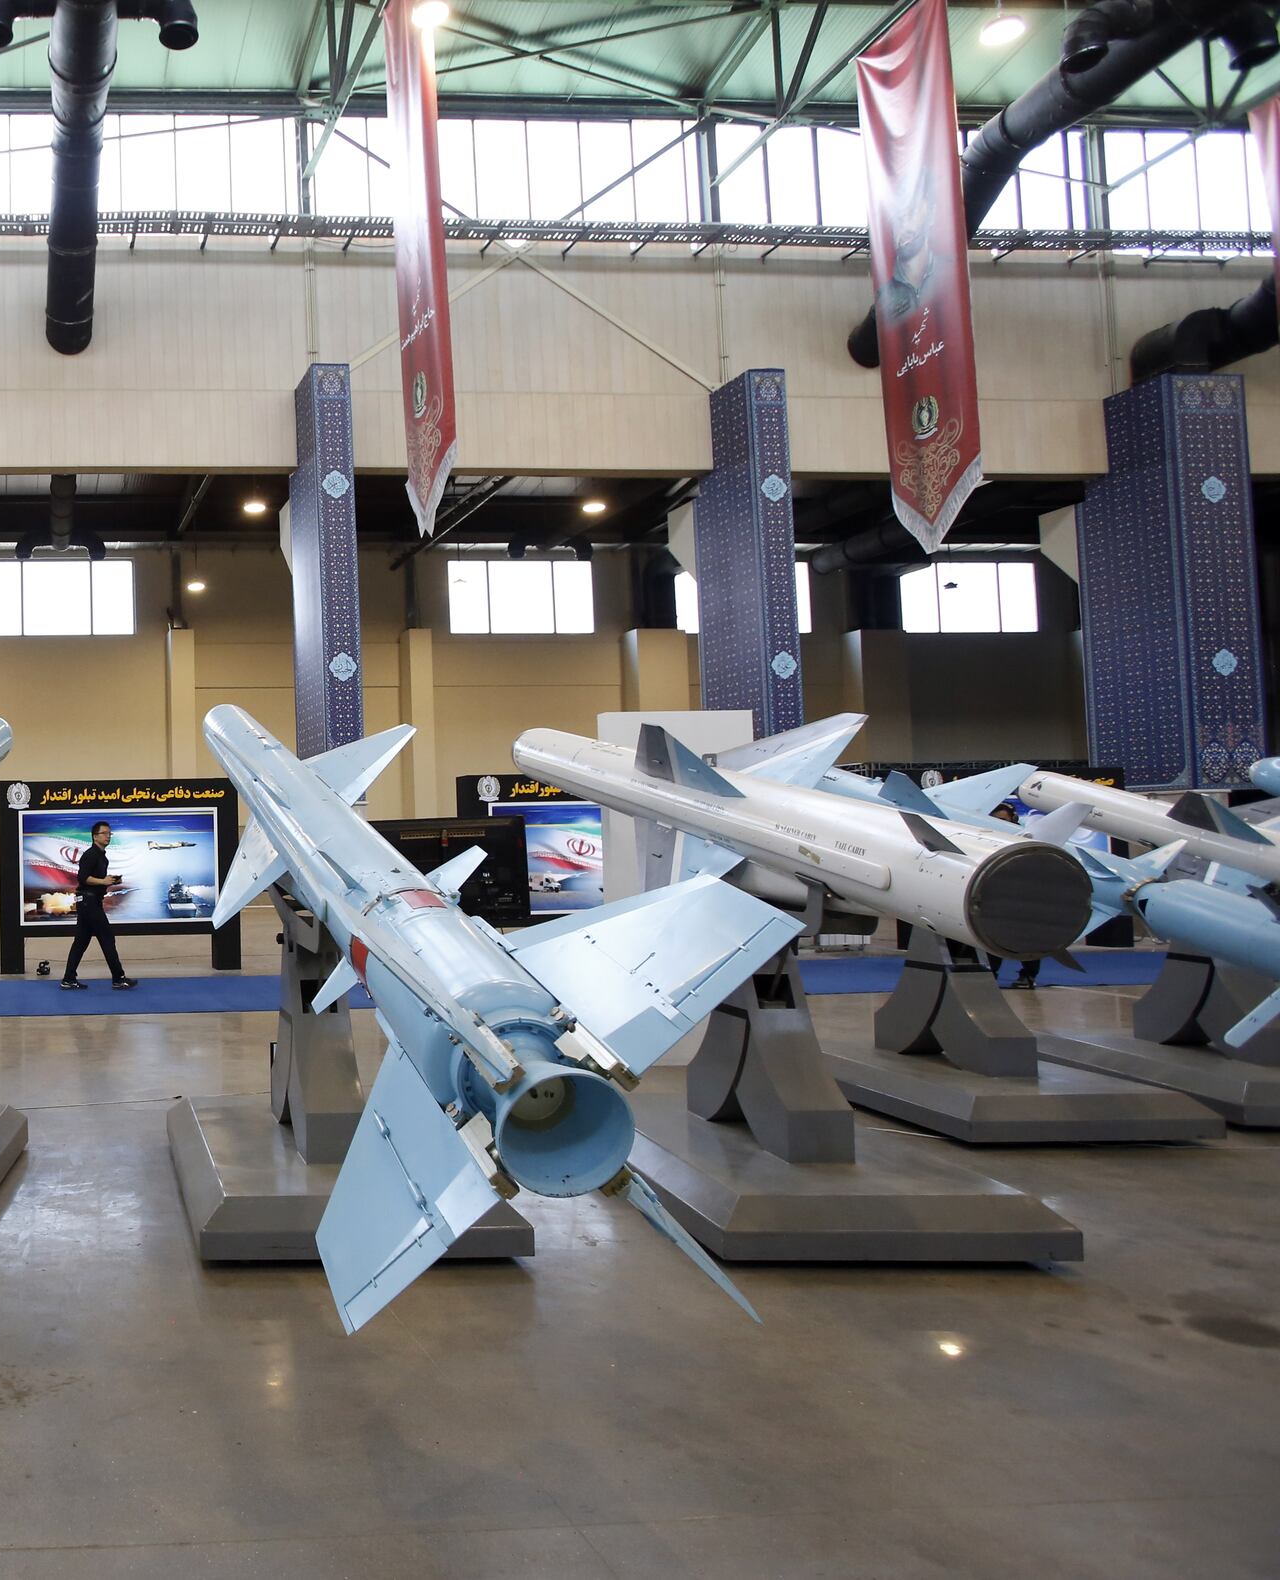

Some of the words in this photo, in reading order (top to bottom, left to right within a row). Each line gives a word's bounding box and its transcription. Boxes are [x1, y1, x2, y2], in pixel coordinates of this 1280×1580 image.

[911, 306, 930, 345] شهید
[918, 341, 945, 366] عباس
[896, 353, 920, 378] بابایی
[40, 788, 71, 805] اقتدار
[71, 787, 97, 805] تبلور
[98, 787, 121, 803] امید
[121, 787, 151, 803] تجلی
[192, 787, 225, 799] صنعت
[509, 780, 539, 798] اقتدار
